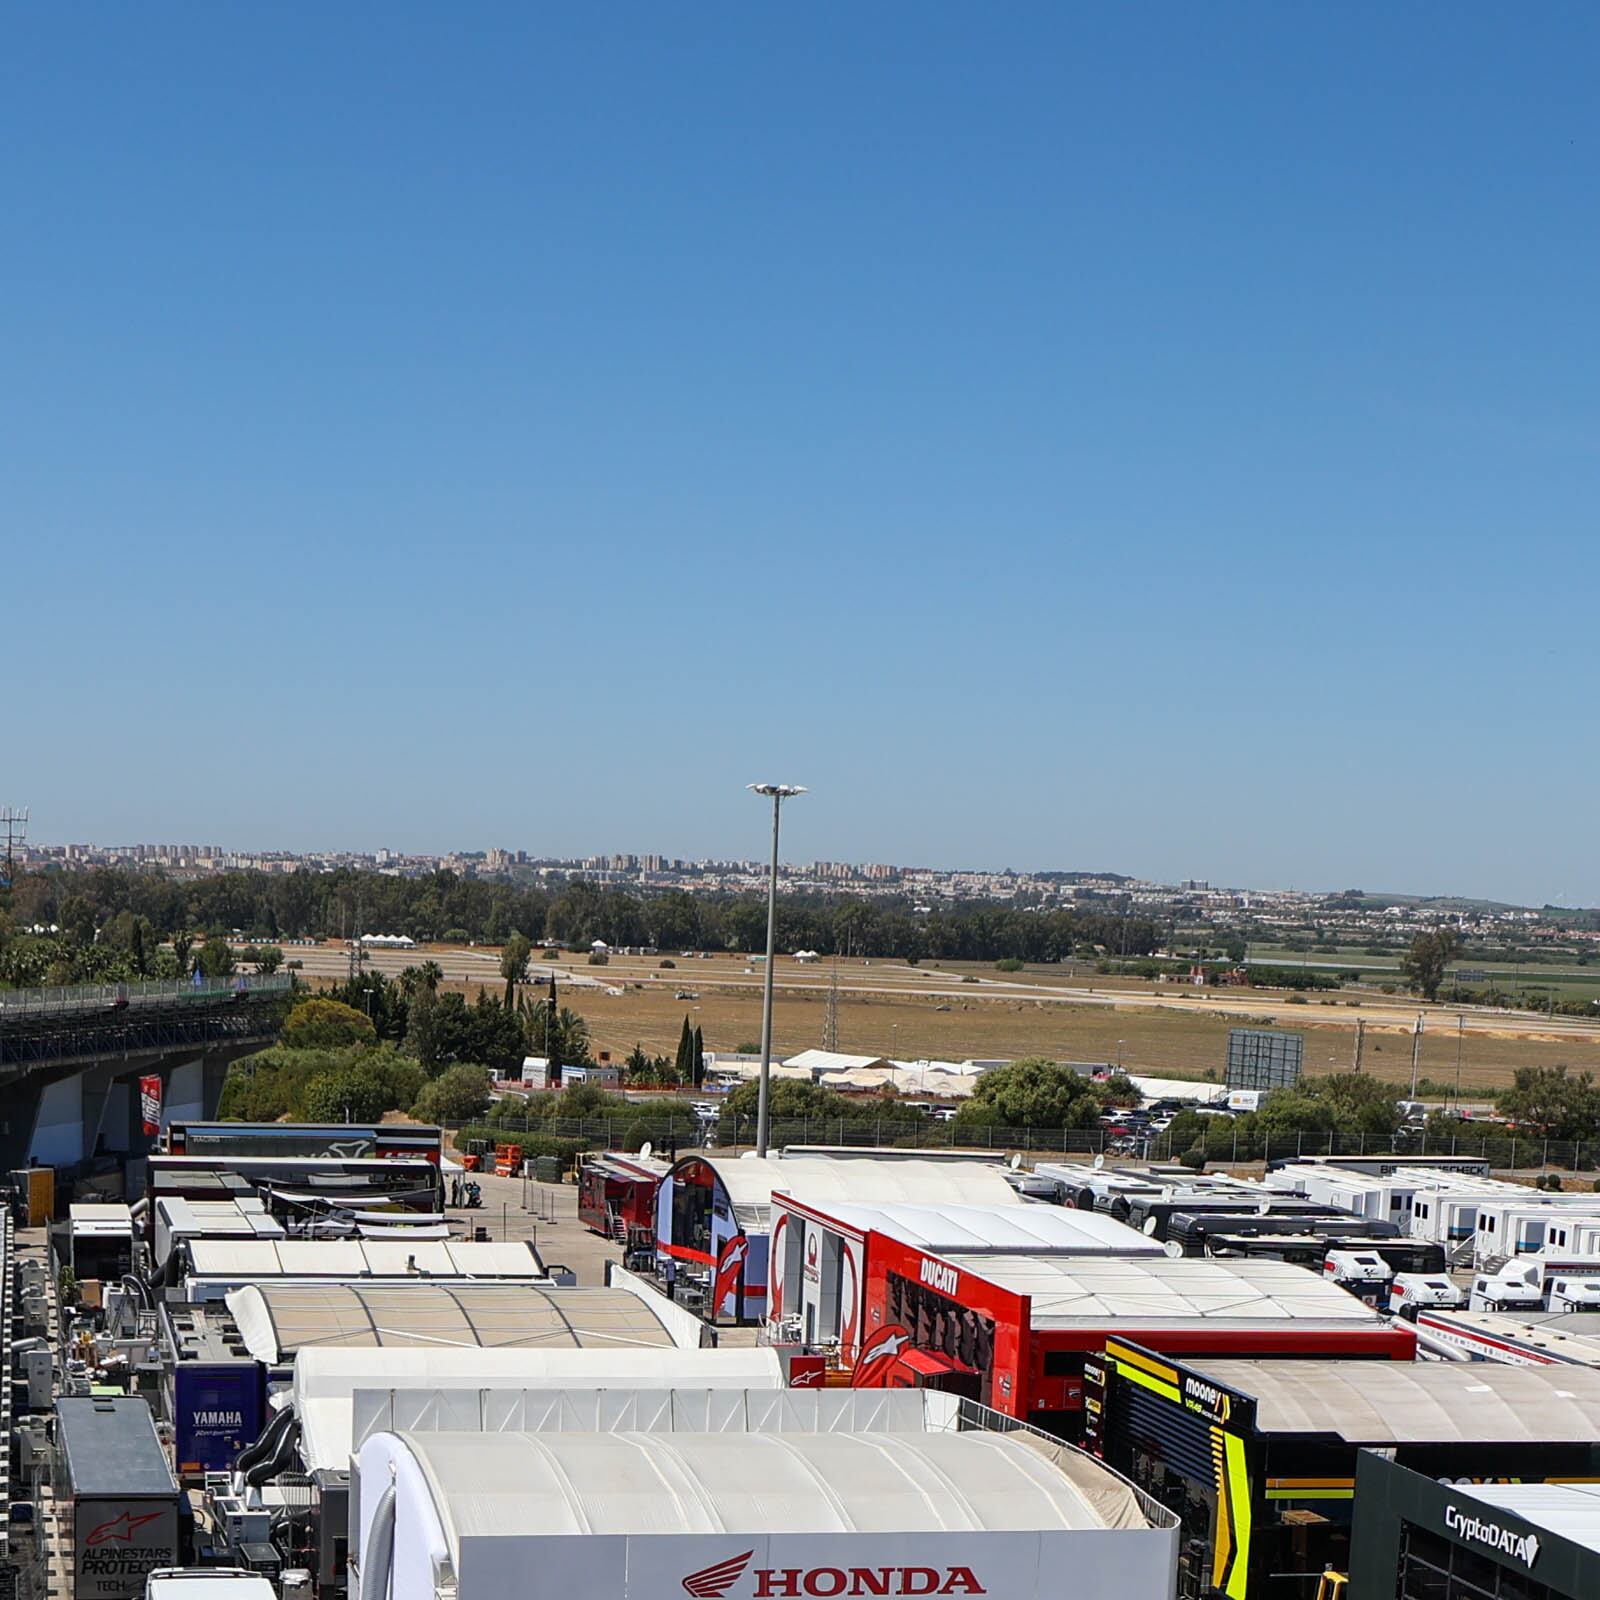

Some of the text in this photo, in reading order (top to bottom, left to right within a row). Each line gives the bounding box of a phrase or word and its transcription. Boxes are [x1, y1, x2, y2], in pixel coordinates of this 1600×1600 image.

[920, 1257, 959, 1296] DUCATI
[1185, 1375, 1222, 1412] mooney
[192, 1411, 242, 1424] YAMAHA
[1445, 1505, 1528, 1561] CryptoDATA
[81, 1547, 172, 1560] ALPINESTARS
[97, 1580, 124, 1592] TECH
[752, 1566, 987, 1599] HONDA
